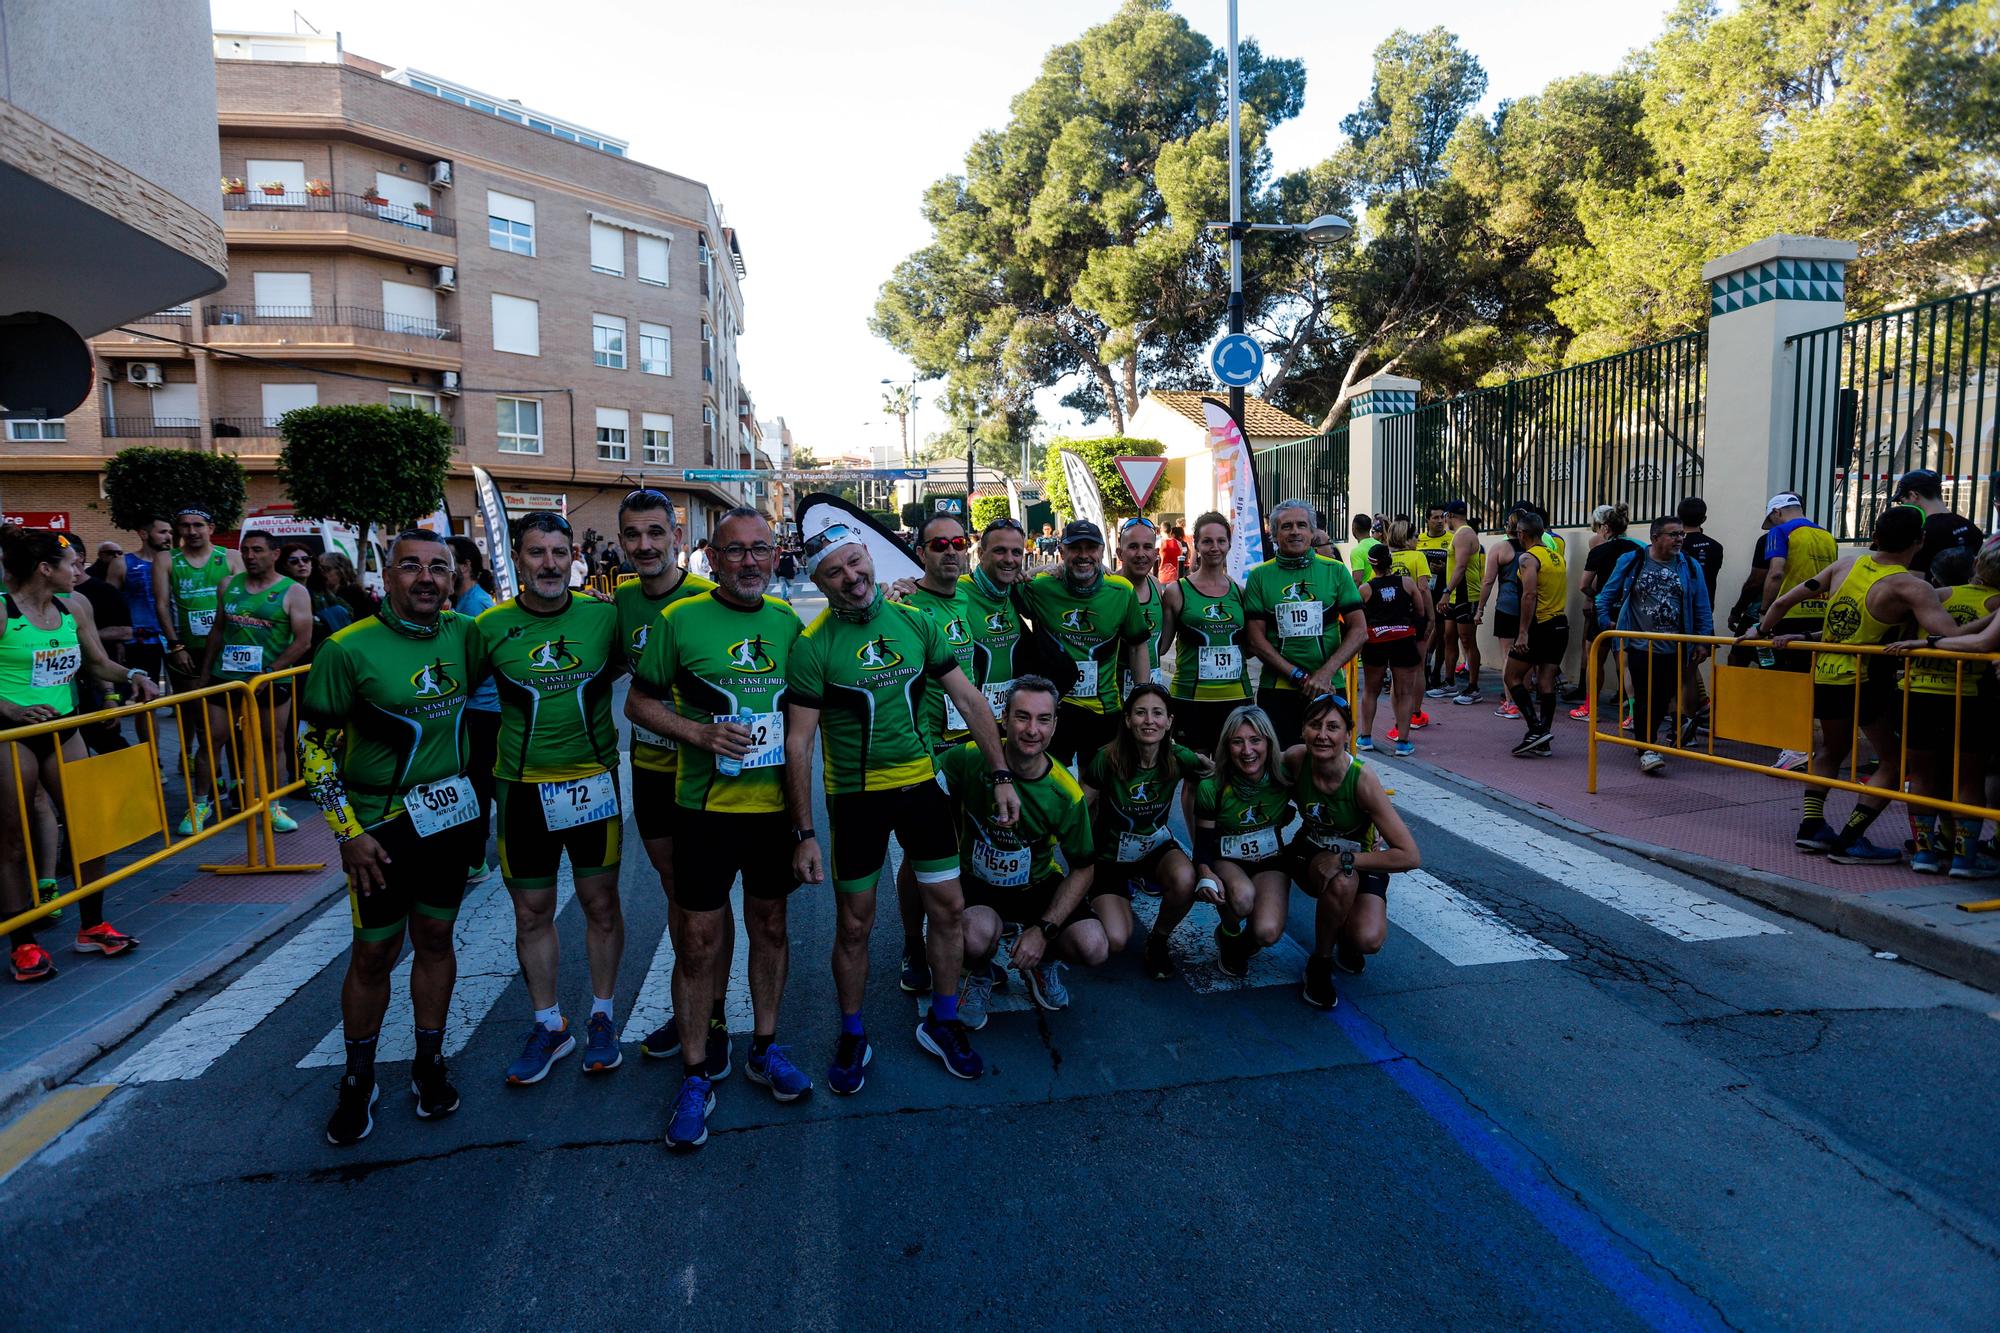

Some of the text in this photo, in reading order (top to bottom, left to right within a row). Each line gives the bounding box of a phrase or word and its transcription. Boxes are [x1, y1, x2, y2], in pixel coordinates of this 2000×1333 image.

[277, 526, 307, 534] MÓVIL
[1291, 609, 1308, 623] 119
[46, 655, 76, 672] 1423
[232, 652, 251, 662] 970
[1215, 654, 1231, 666] 131
[540, 675, 564, 683] SENSE
[738, 677, 761, 685] SENSE
[871, 672, 893, 682] SENSE
[423, 786, 459, 811] 309
[567, 785, 591, 806] 72
[1241, 840, 1259, 856] 93
[985, 855, 1018, 873] 1549
